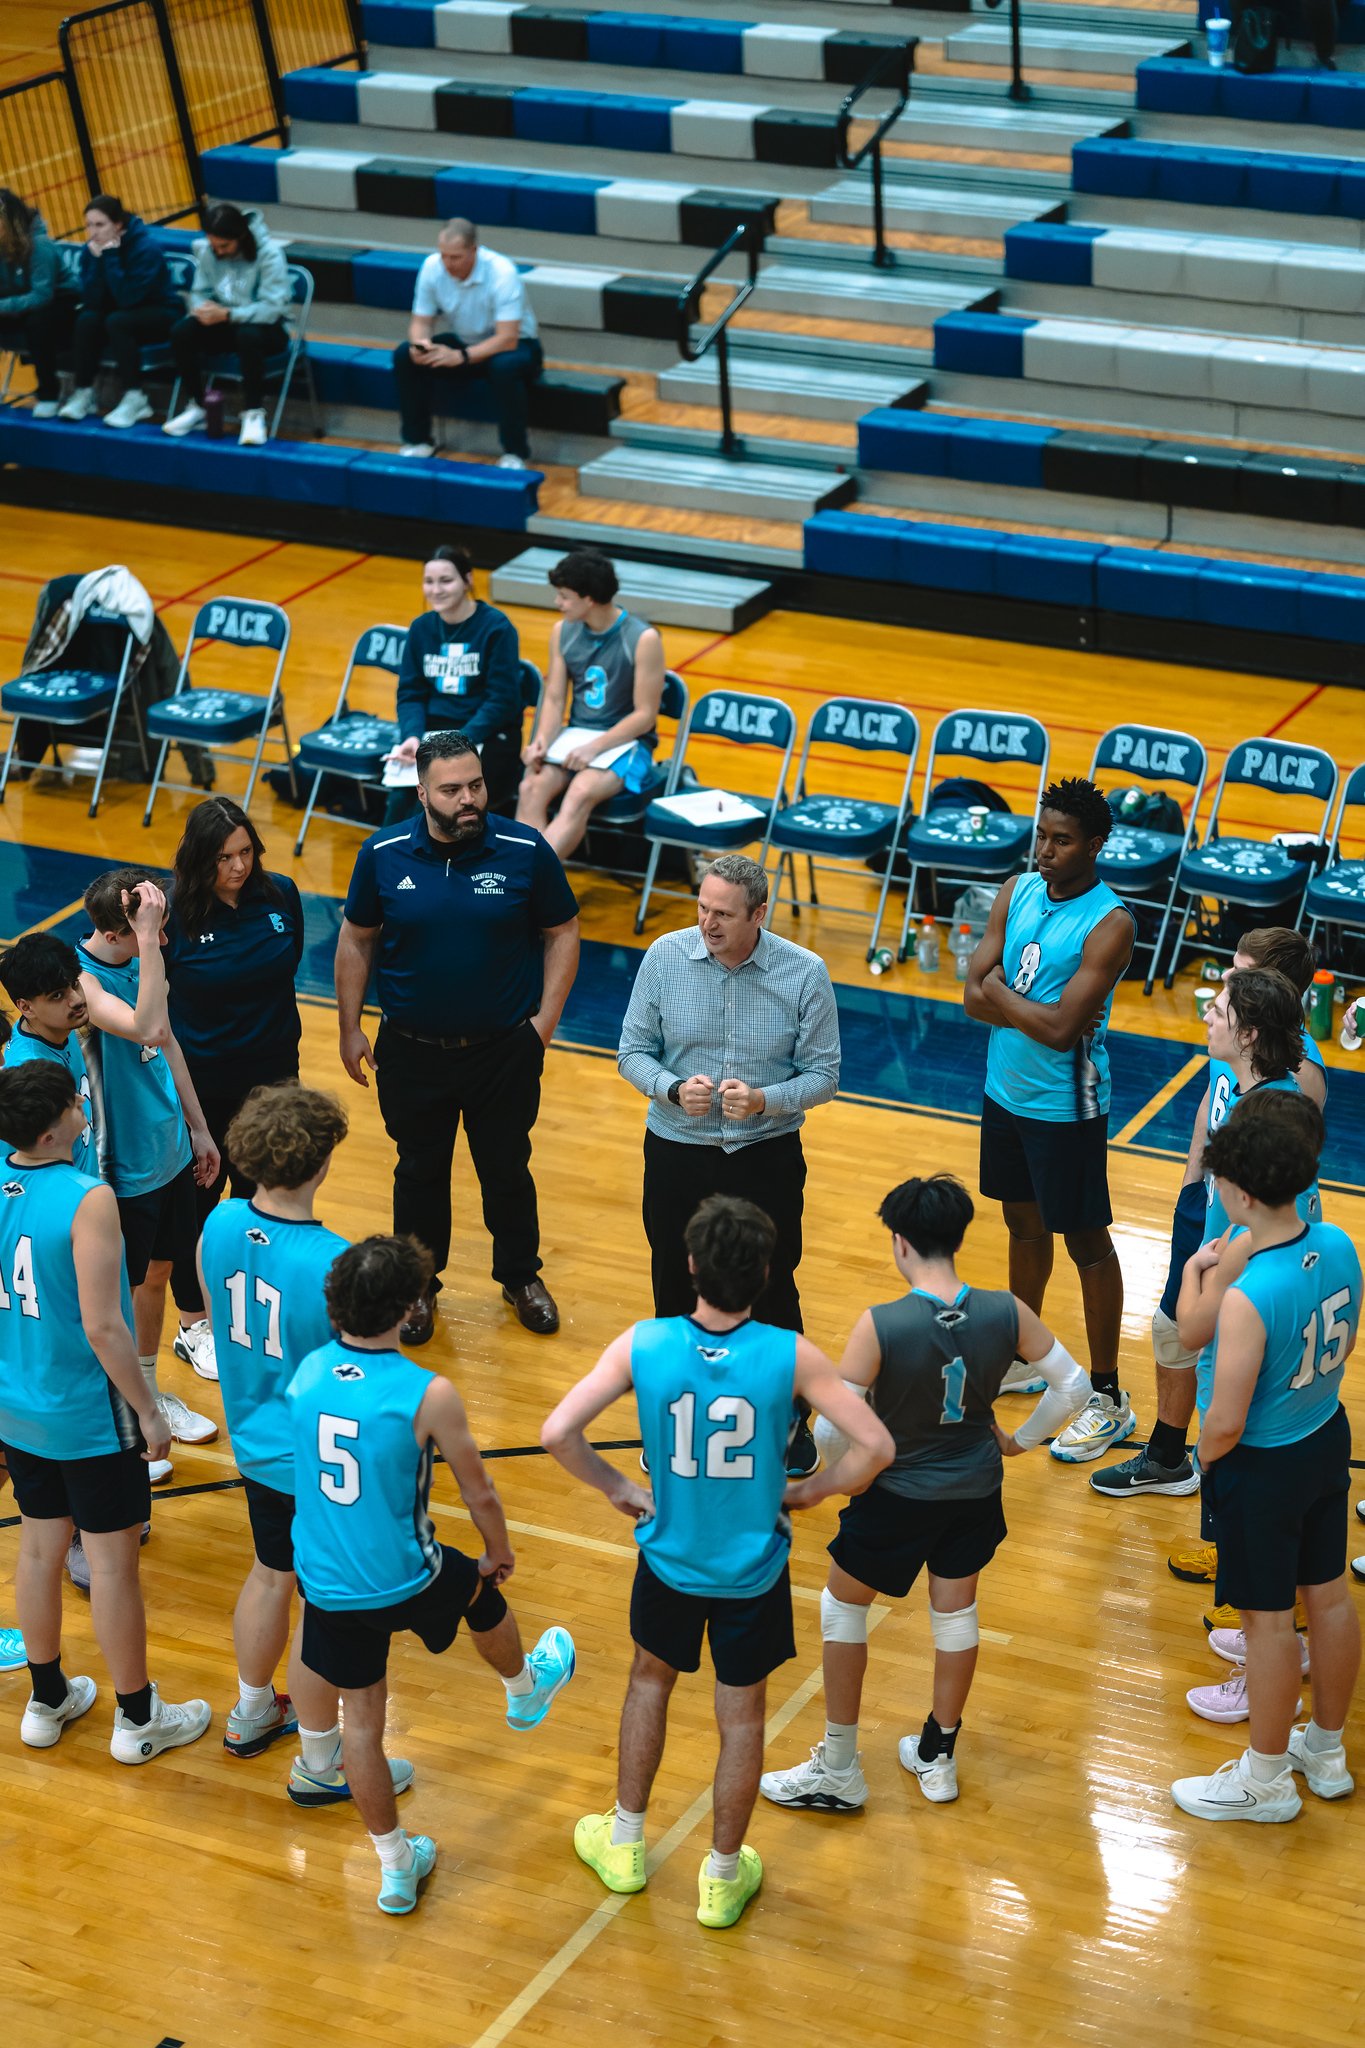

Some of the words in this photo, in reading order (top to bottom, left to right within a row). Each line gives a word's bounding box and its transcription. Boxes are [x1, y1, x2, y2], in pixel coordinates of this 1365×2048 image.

[206, 605, 273, 642] PACK
[584, 665, 608, 709] 3
[704, 697, 778, 738] PACK
[824, 705, 901, 745] PACK
[951, 719, 1030, 757] PACK
[1111, 733, 1190, 776] PACK
[1241, 747, 1320, 789] PACK
[473, 887, 505, 895] VOLLEYBALL
[1013, 942, 1042, 995] 8
[1210, 1073, 1231, 1132] 6
[224, 1269, 284, 1360] 17
[1288, 1285, 1351, 1390] 15
[940, 1355, 967, 1425] 1
[668, 1391, 757, 1480] 12
[318, 1411, 362, 1507] 5
